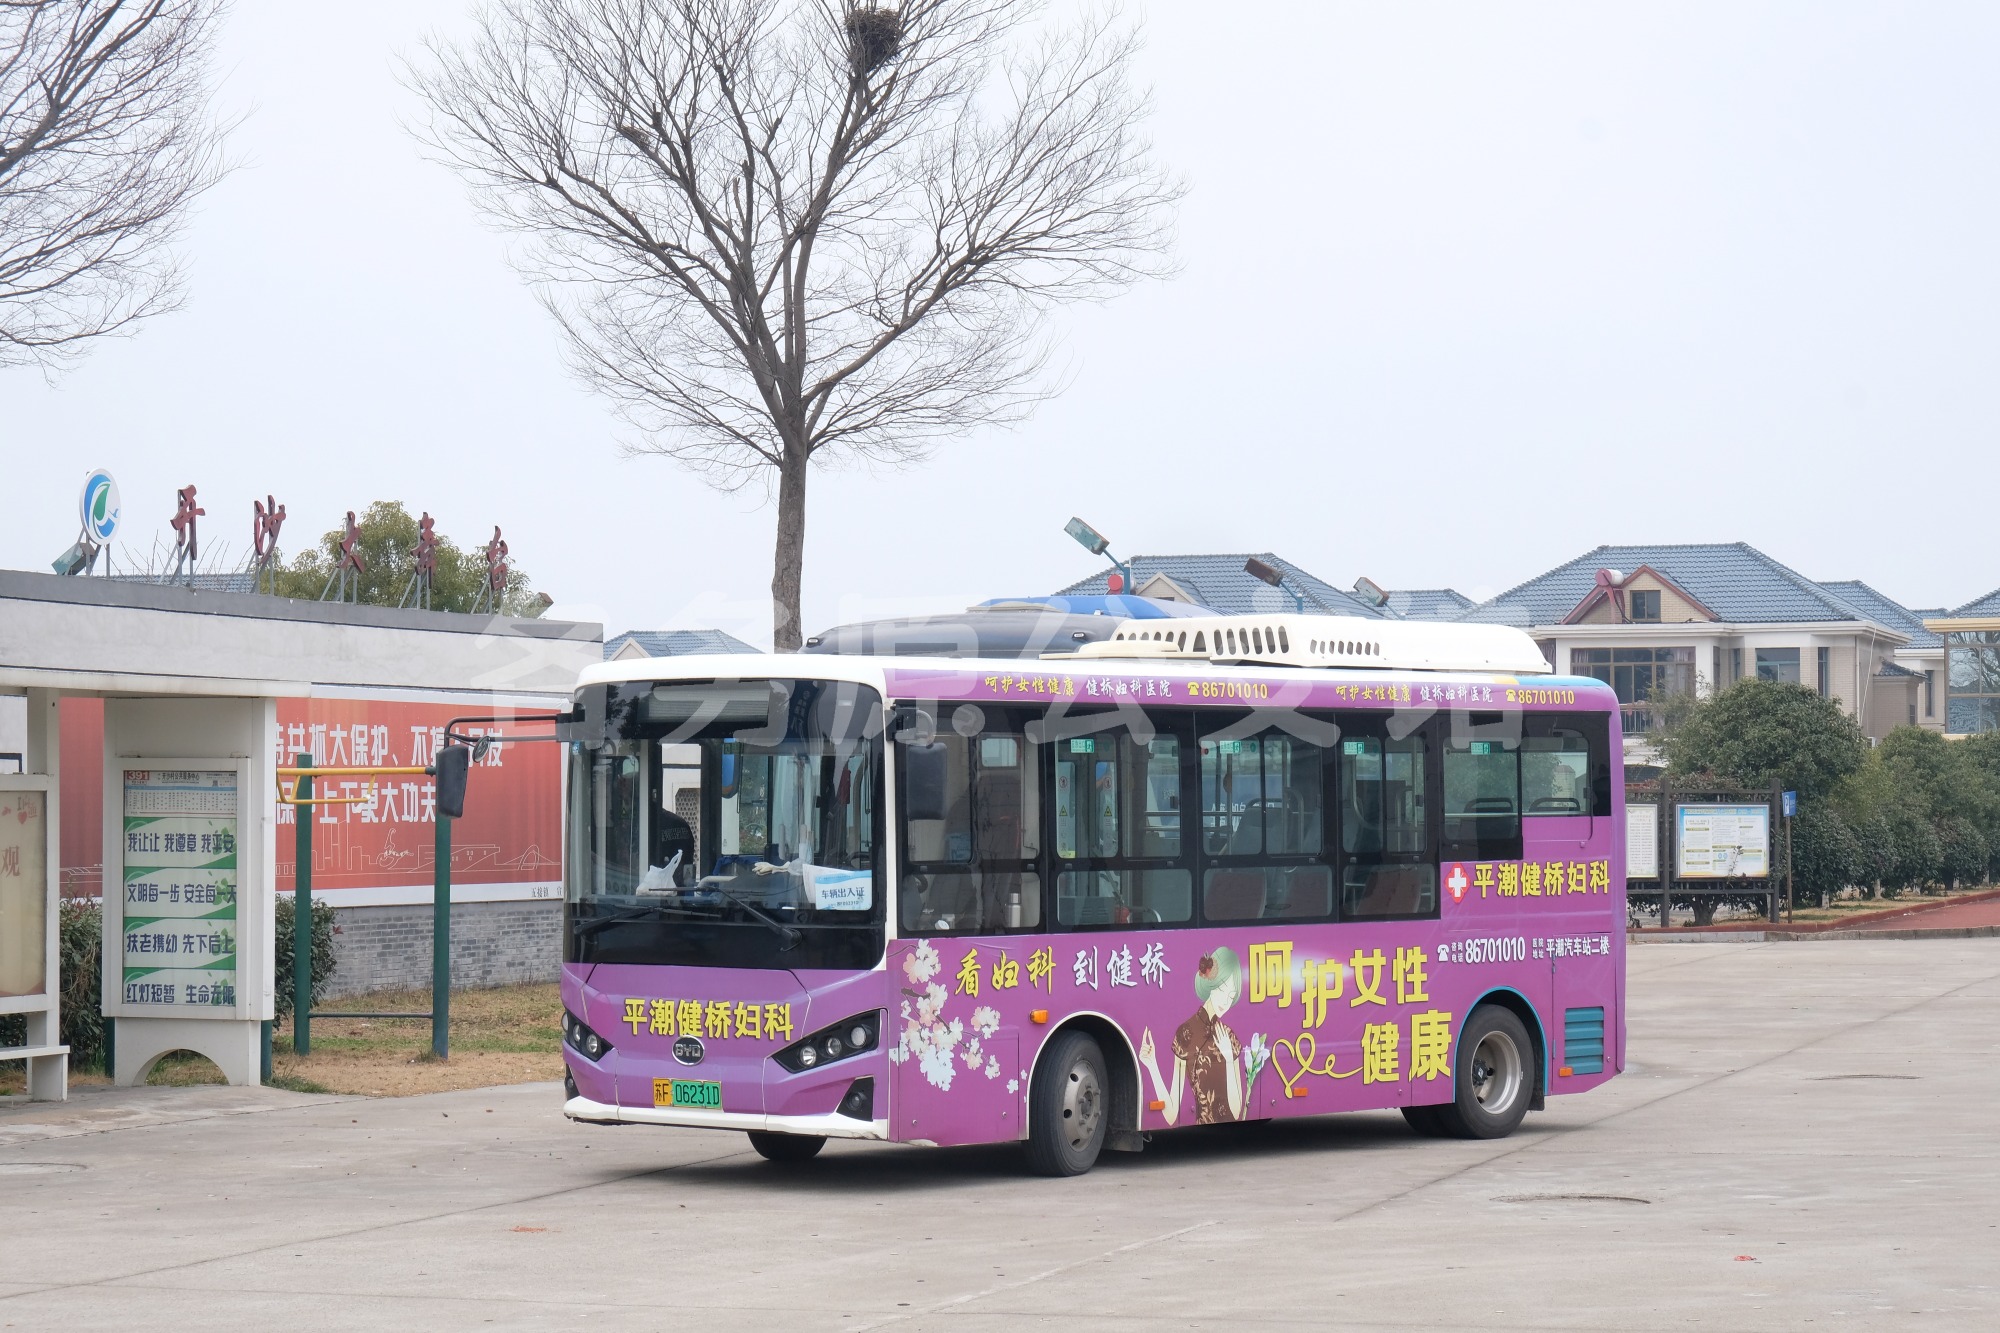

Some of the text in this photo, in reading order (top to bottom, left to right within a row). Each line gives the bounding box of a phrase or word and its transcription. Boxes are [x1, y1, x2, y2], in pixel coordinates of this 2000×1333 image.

[170, 484, 508, 589] 开沙大舞台
[984, 675, 1268, 700] 呵护女性健康 健桥妇科医院 86701010
[1335, 684, 1575, 705] 呵护女性健康 健桥妇科医院 86701010
[127, 771, 149, 780] 391
[127, 833, 235, 853] 我让让 我遵章 我平安
[1474, 860, 1610, 898] 平潮健桥妇科
[127, 883, 237, 904] 文明每一步 安全每一天
[821, 887, 865, 899] 车辆出入证
[126, 934, 235, 954] 扶老携幼 先下后上
[1465, 936, 1526, 964] 86701010
[1546, 936, 1611, 957] 平潮汽车站二楼
[955, 943, 1171, 998] 看妇科 到健桥
[126, 984, 235, 1005] 红灯短暂 生命无限
[1249, 941, 1429, 1029] 呵护女性
[622, 998, 794, 1041] 平潮健桥妇科
[675, 1044, 701, 1057] BYD
[1362, 1010, 1452, 1085] 健康
